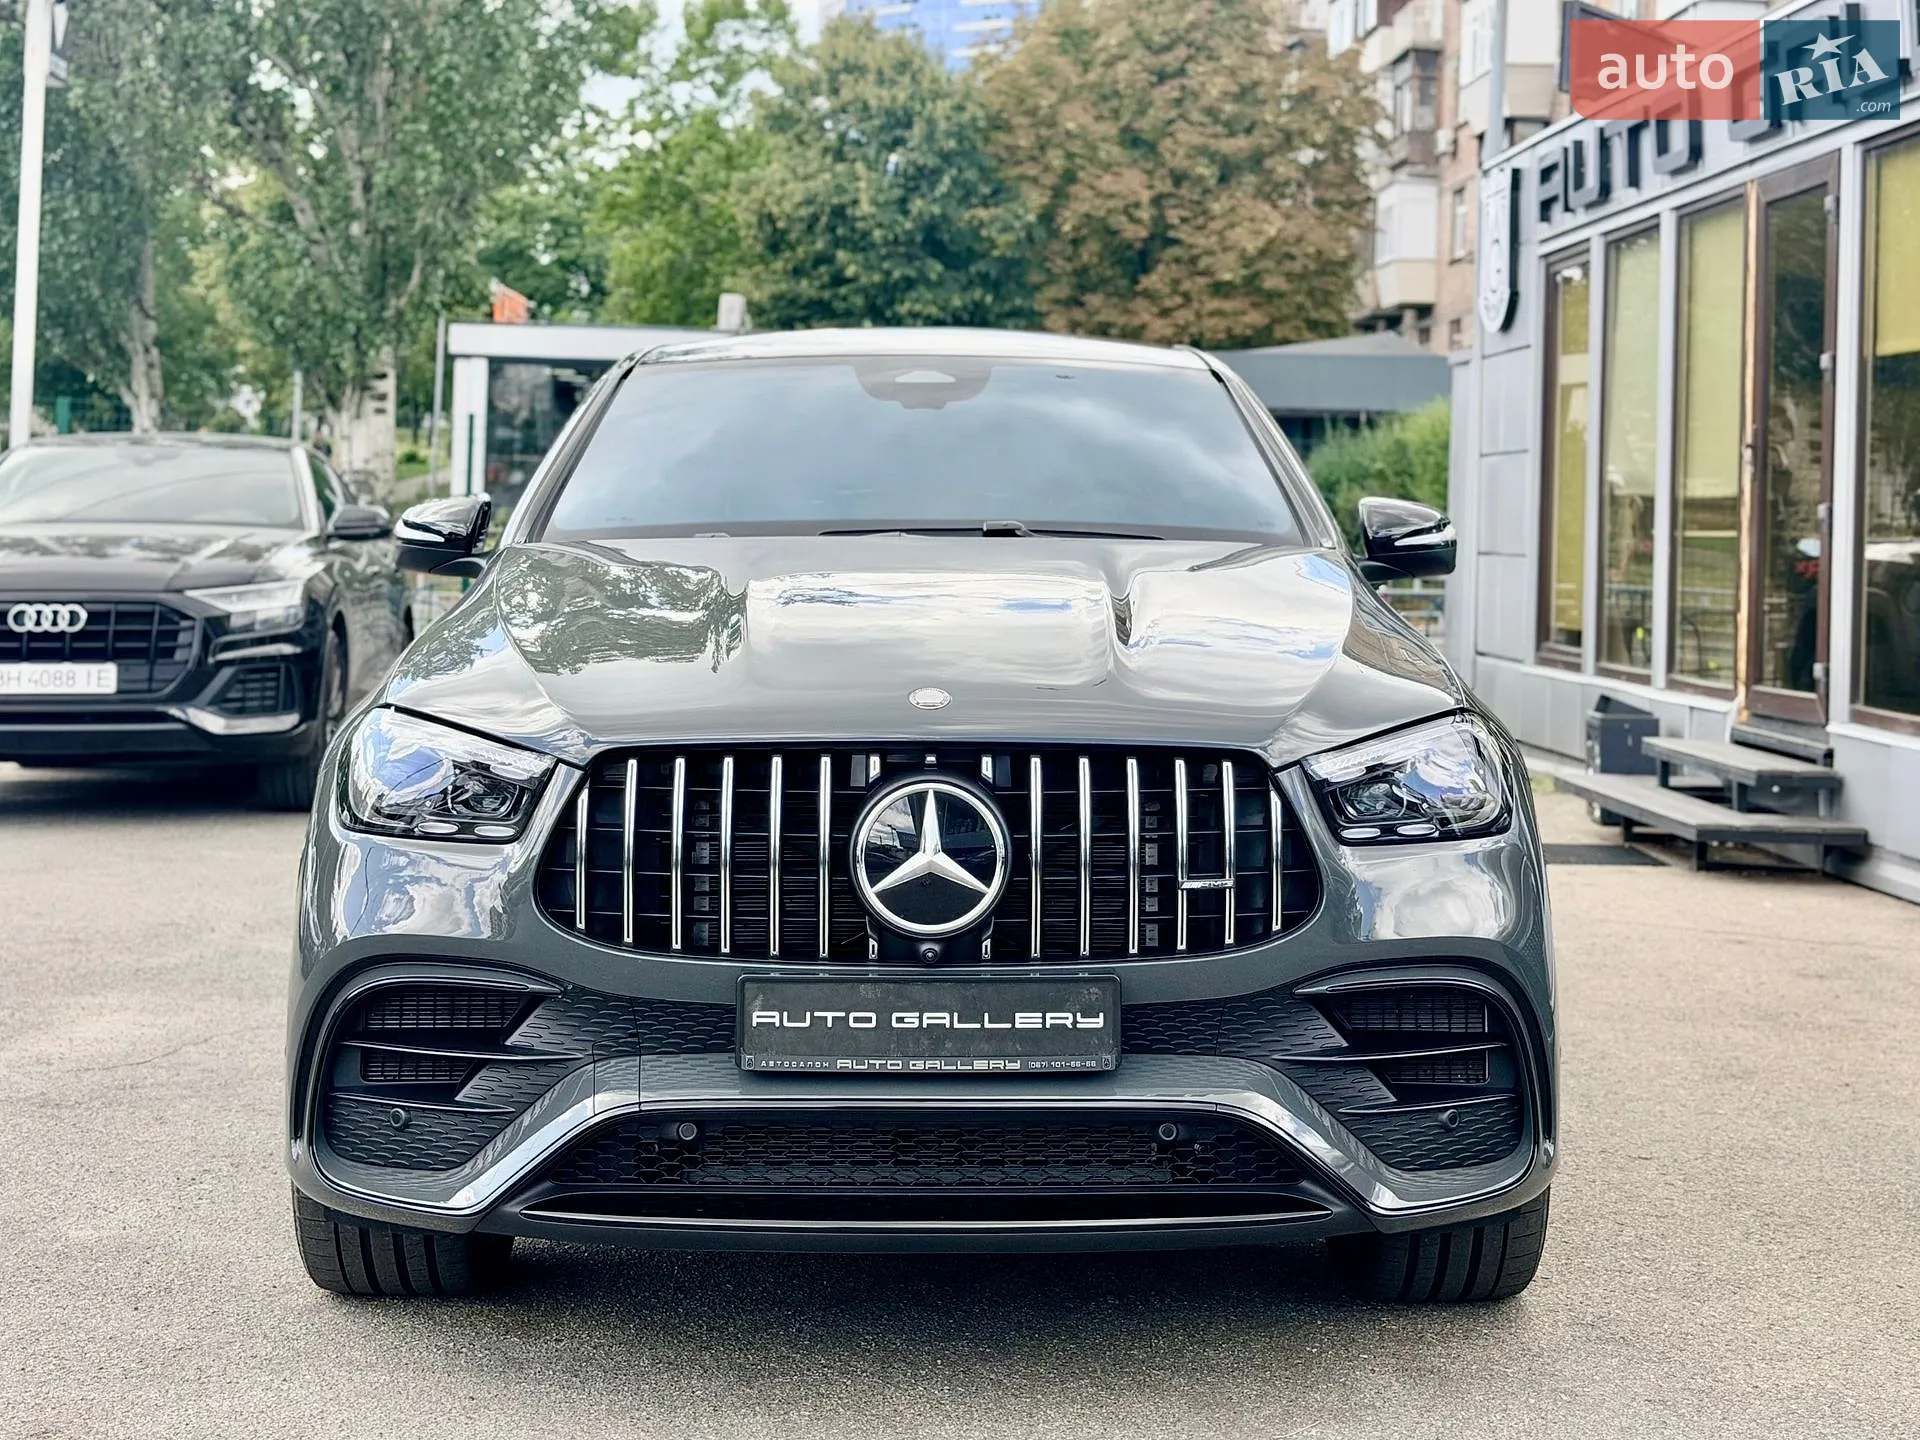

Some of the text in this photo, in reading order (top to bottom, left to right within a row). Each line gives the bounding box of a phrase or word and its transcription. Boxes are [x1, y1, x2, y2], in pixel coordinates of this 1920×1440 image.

[1538, 90, 1702, 223] AUTO
[752, 1011, 1104, 1028] AUTO GALLERY
[760, 1060, 830, 1068] АВТОСАЛОН
[836, 1059, 903, 1070] AUTO
[909, 1059, 1021, 1070] GALLERY
